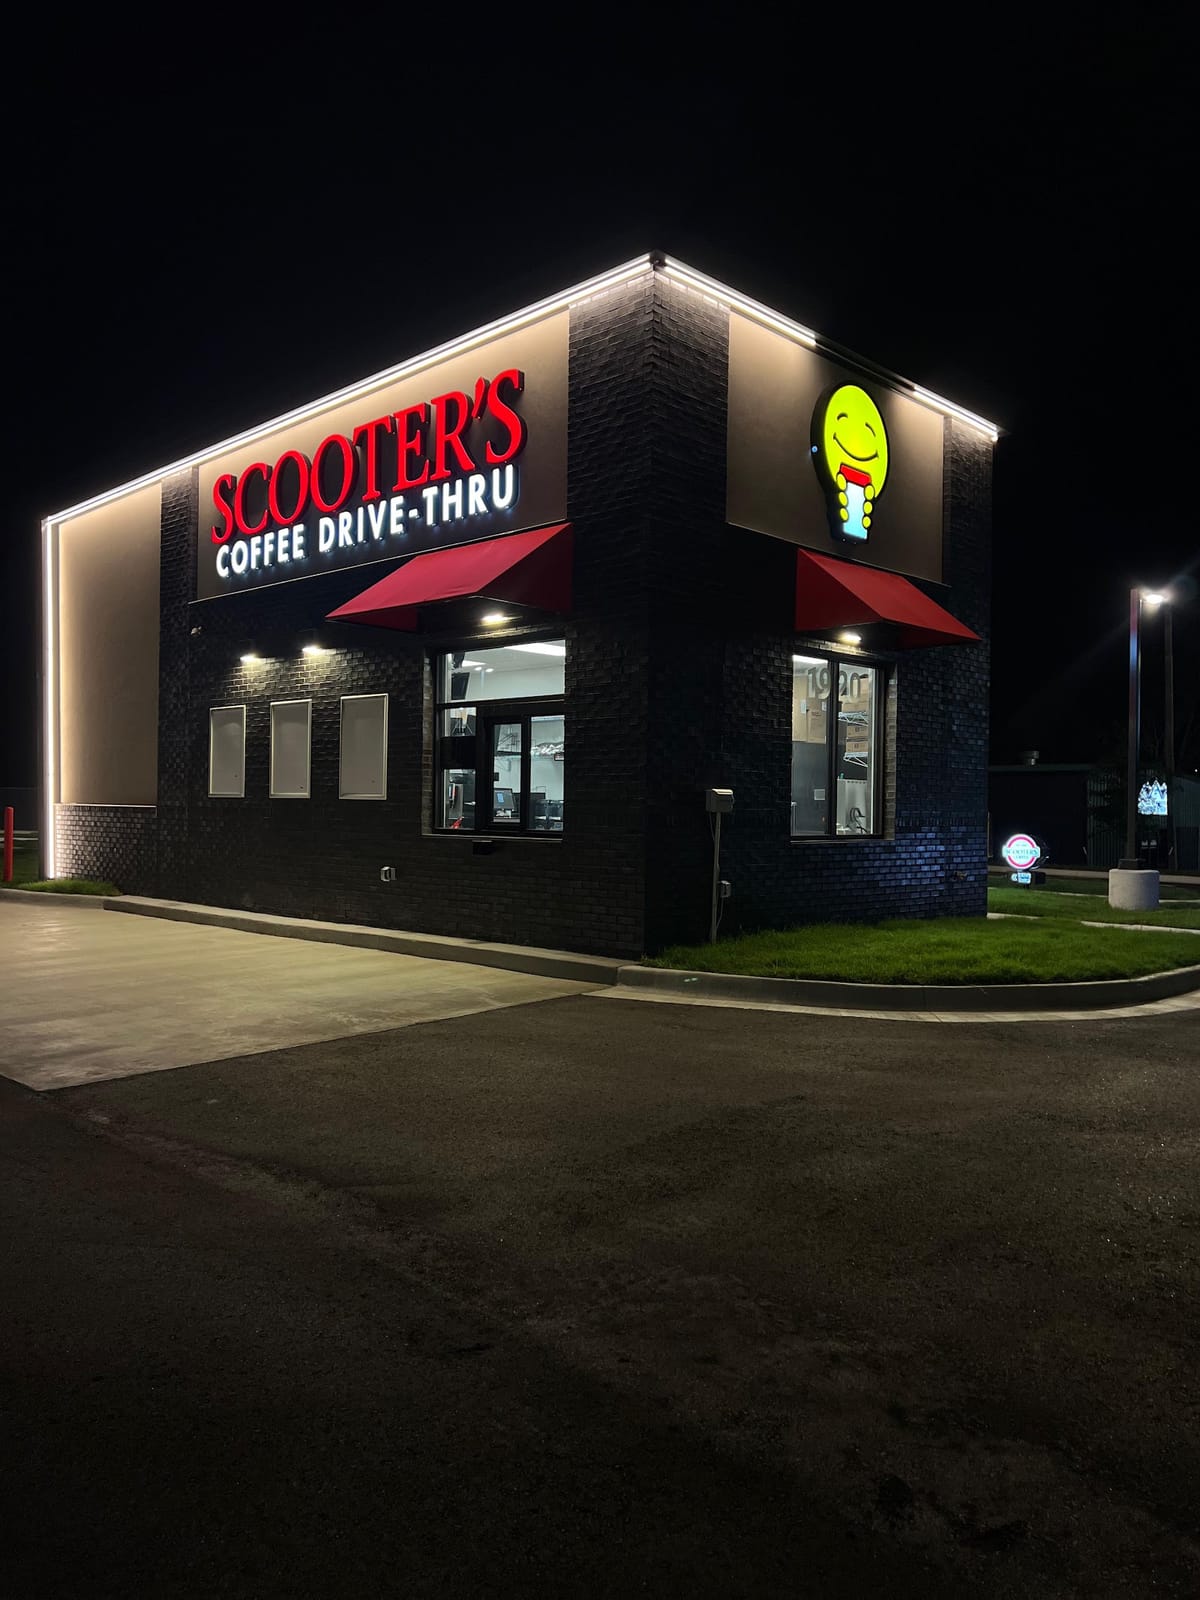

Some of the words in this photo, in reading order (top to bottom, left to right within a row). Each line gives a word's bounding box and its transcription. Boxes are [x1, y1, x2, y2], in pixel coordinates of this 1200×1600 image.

[211, 368, 524, 545] SCOOTER'S
[215, 523, 305, 578] COFFEE
[318, 464, 515, 553] DRIVE-THRU
